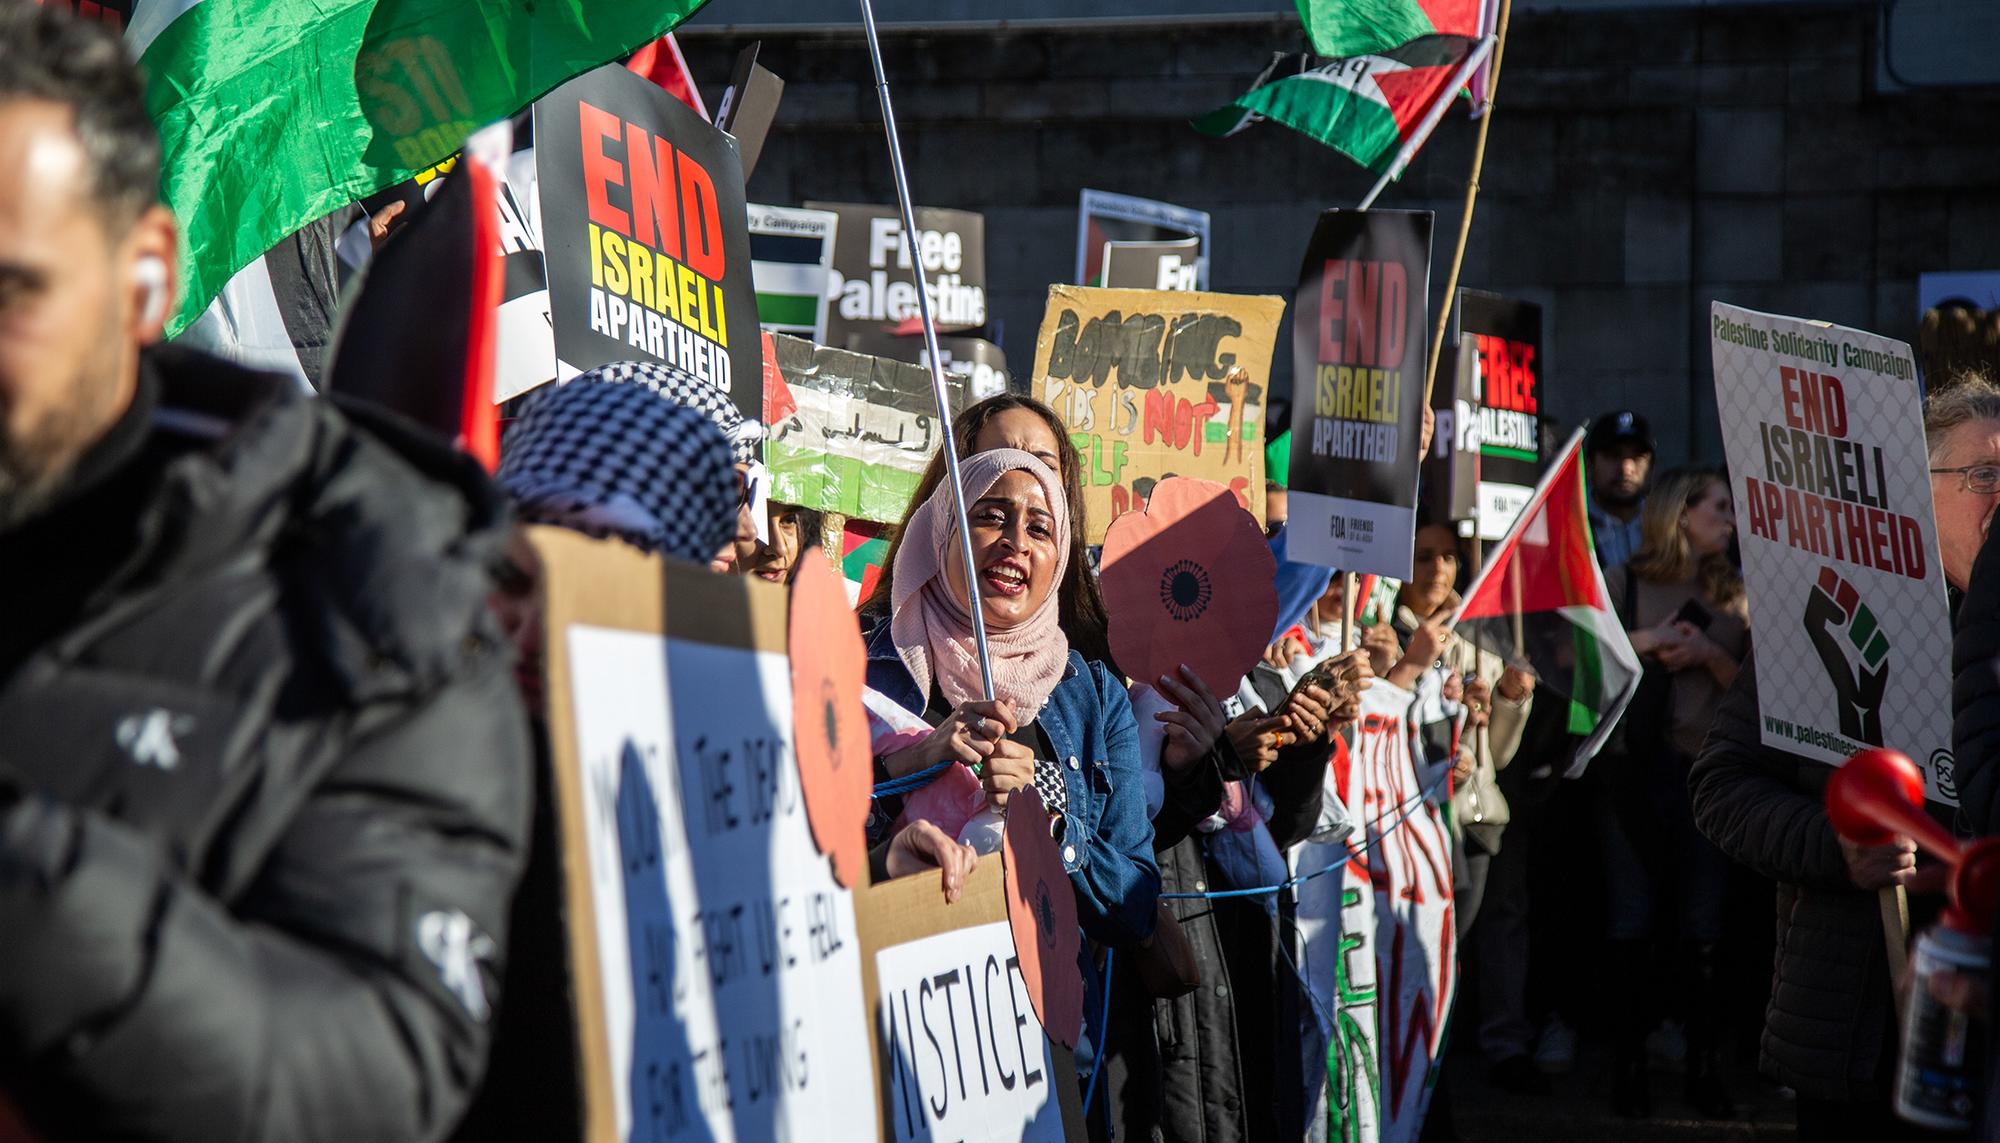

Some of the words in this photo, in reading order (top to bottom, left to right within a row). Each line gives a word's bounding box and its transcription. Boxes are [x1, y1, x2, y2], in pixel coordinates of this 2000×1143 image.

[579, 100, 725, 282] END
[869, 217, 962, 272] Free
[588, 223, 728, 348] ISRAELI
[1317, 258, 1407, 369] END
[590, 287, 732, 394] APARTHEID
[1713, 314, 1768, 351] Palestine
[1772, 329, 1838, 368] Solidarity
[1843, 342, 1914, 381] Campaign
[1143, 387, 1220, 458] NOT
[1315, 363, 1400, 424] ISRAELI
[1780, 366, 1848, 438] END
[1069, 433, 1128, 487] ELF
[1312, 418, 1399, 464] APARTHEID
[1760, 422, 1888, 510] ISRAELI
[1331, 515, 1346, 540] FOA
[1746, 476, 1927, 580] APARTHEID
[1936, 763, 1953, 783] PS
